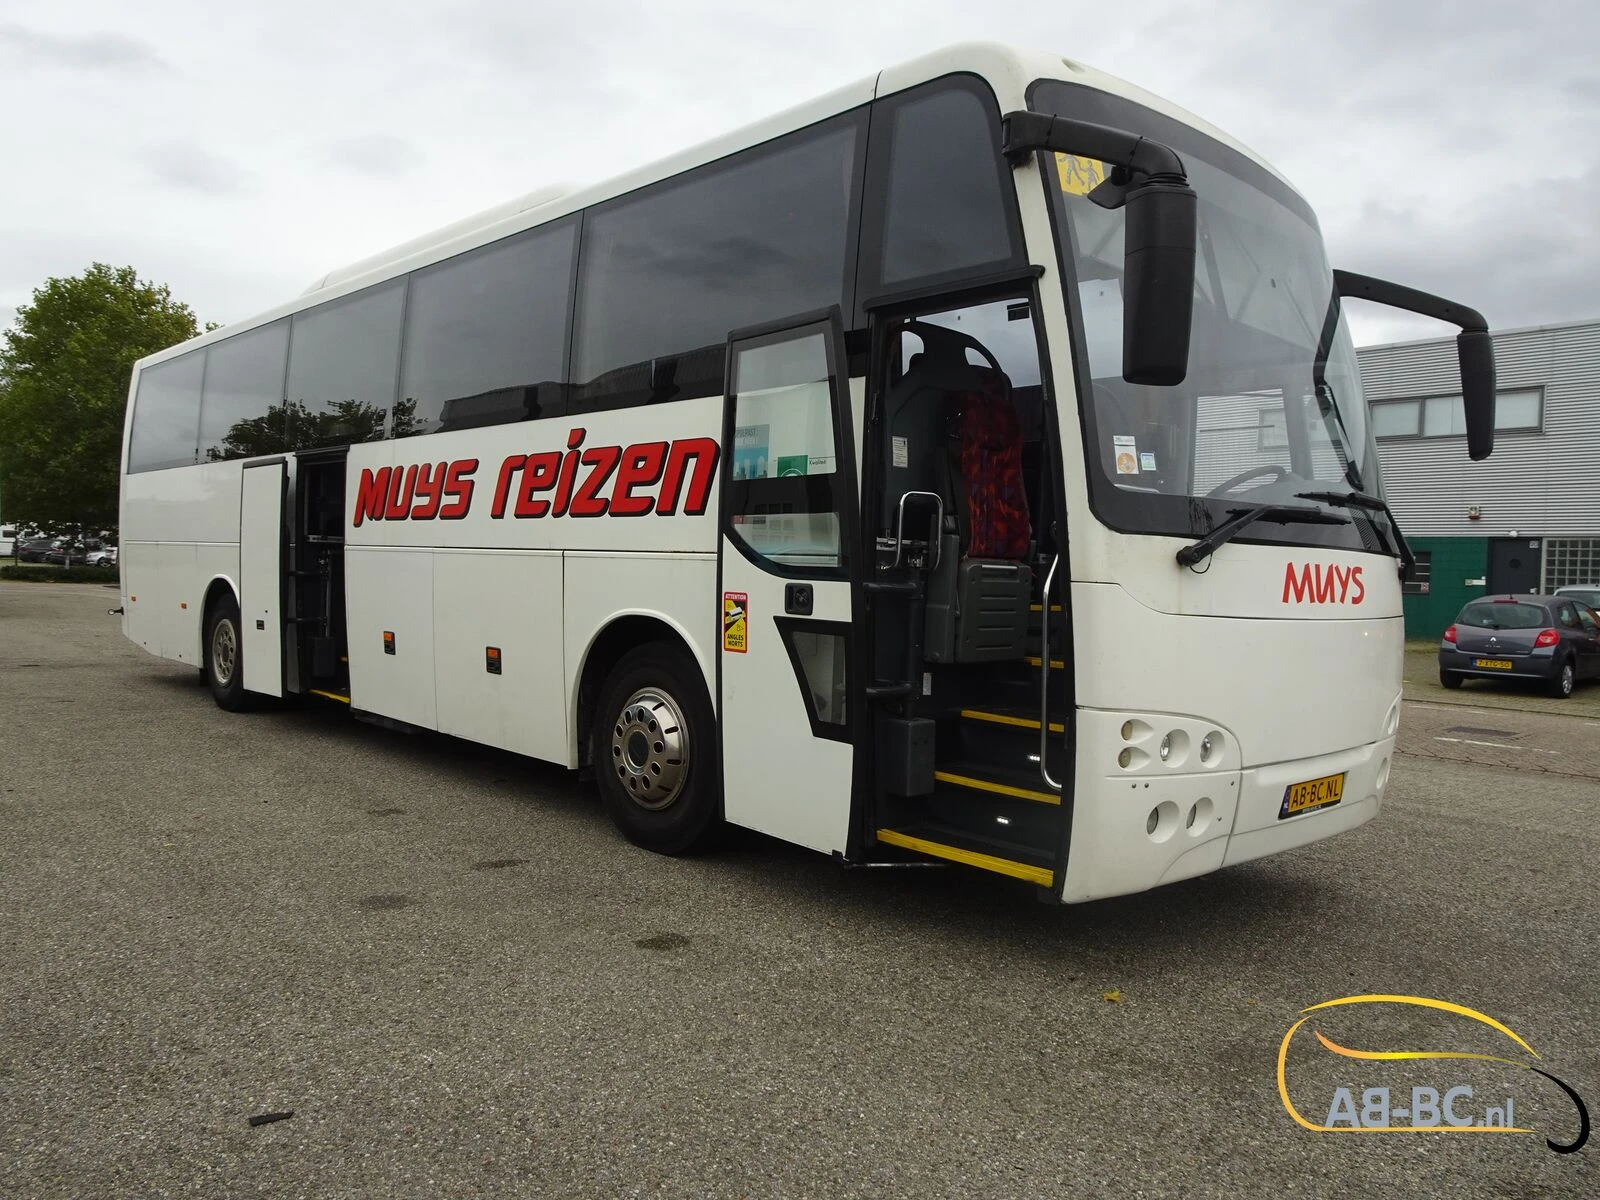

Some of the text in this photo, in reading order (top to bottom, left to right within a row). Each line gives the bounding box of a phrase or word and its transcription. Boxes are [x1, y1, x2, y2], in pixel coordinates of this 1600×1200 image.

[491, 428, 721, 519] reizen
[1282, 562, 1365, 605] MUYS
[727, 633, 744, 641] ANGLES
[728, 640, 743, 648] MORTS
[1291, 778, 1339, 808] AB-BC.NL
